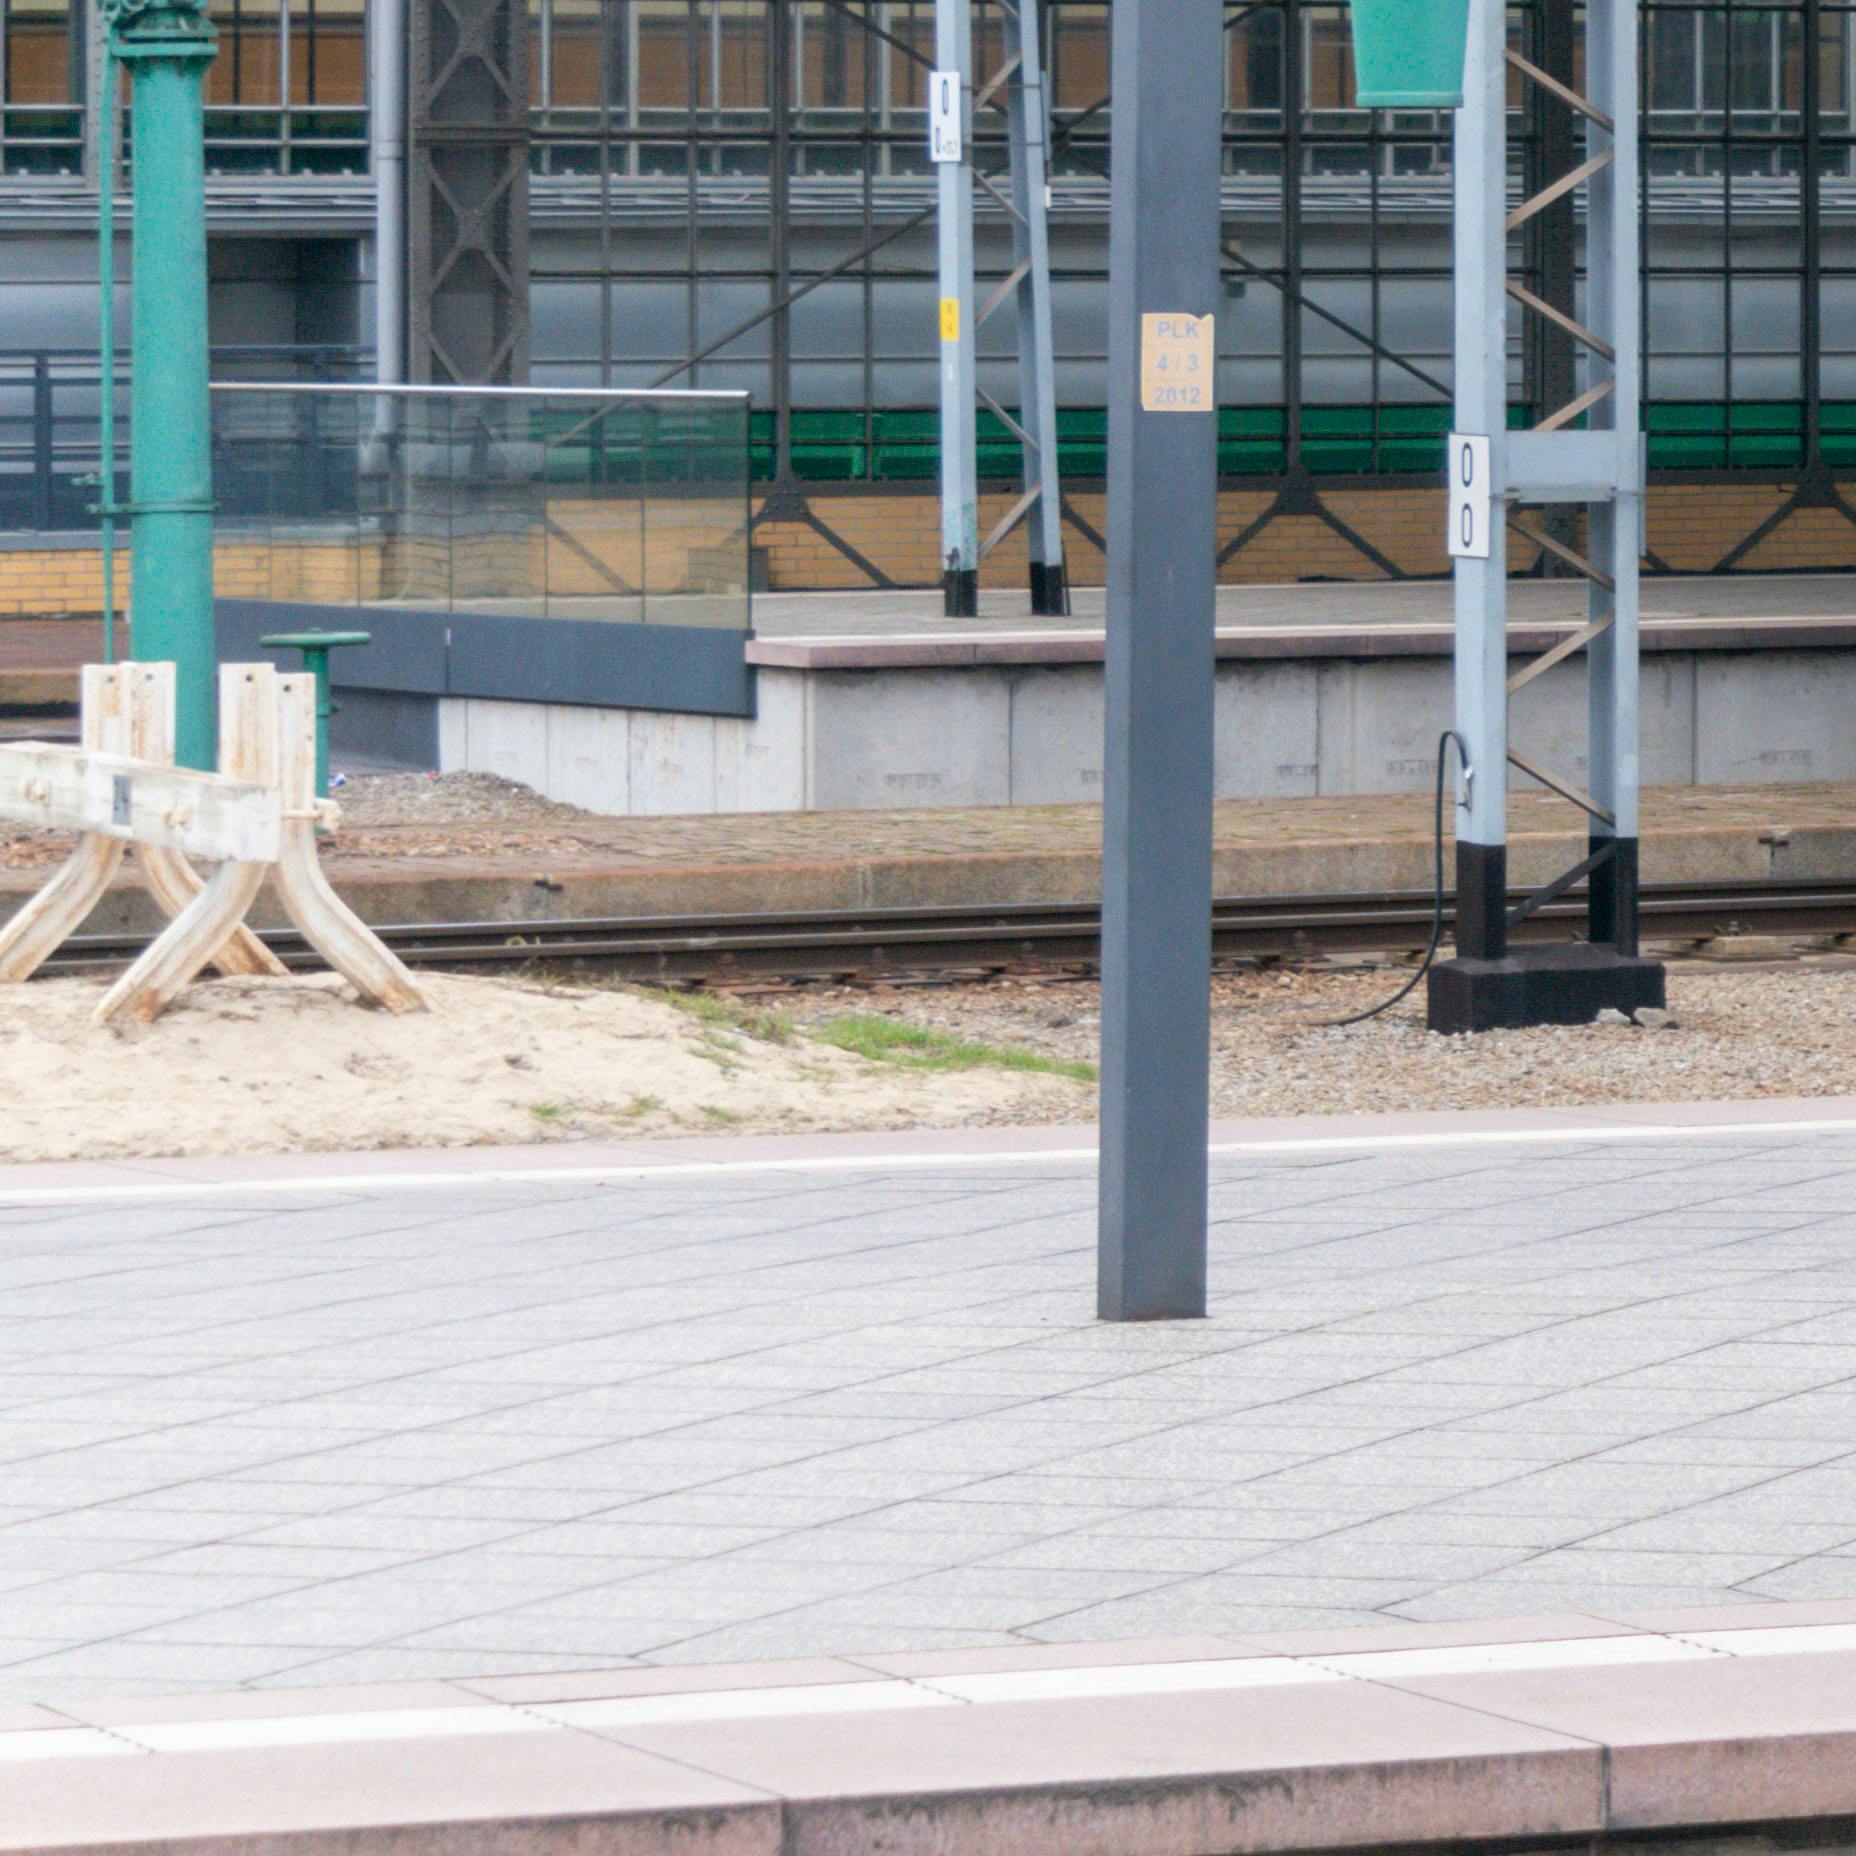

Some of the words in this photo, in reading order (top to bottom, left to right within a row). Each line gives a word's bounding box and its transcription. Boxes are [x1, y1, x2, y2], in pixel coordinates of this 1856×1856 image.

[1157, 320, 1200, 339] PLK
[1153, 386, 1202, 405] 2012
[1462, 443, 1473, 487] 0
[1462, 503, 1473, 547] 0
